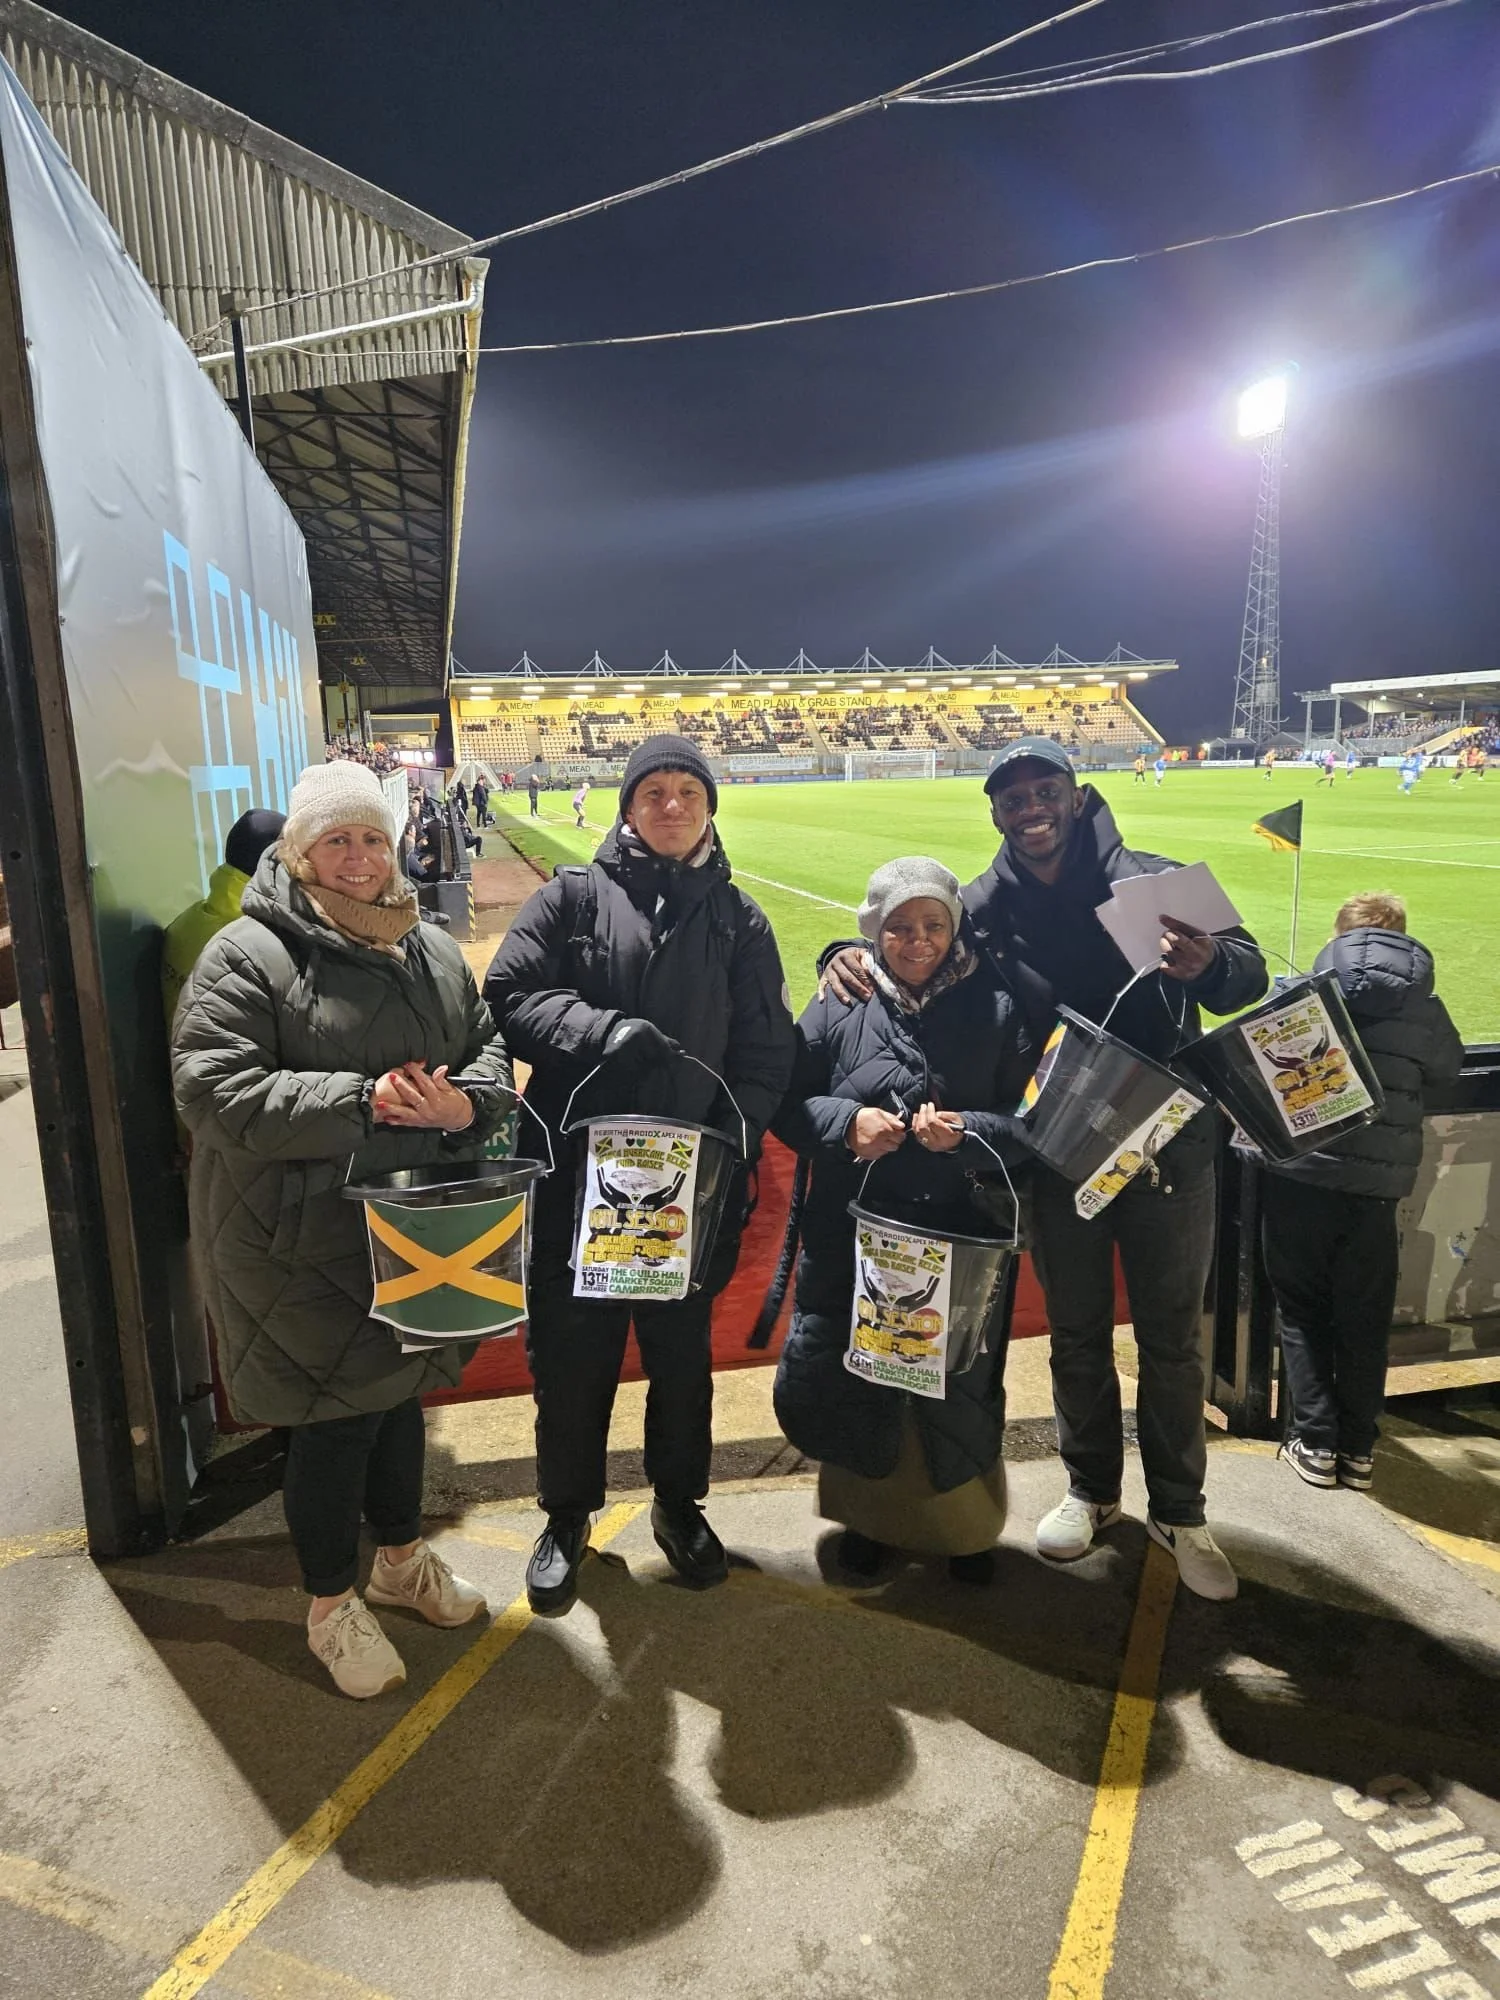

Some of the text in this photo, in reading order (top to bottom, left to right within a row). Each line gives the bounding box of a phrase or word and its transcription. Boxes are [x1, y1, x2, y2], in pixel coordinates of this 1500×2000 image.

[937, 693, 957, 701] MEAD
[1000, 692, 1020, 700] MEAD
[1063, 689, 1083, 697] MEAD
[510, 702, 533, 710] MEAD
[582, 701, 605, 709] MEAD
[653, 700, 674, 708] MEAD
[731, 696, 872, 709] MEAD PLANT & GRAB STAND
[569, 765, 591, 773] MEAD
[610, 764, 627, 772] MEA
[1290, 1111, 1318, 1129] 13TH
[615, 1158, 664, 1171] FUND RAISER
[623, 1147, 665, 1161] HURRICANE
[665, 1153, 692, 1171] RELIEF
[622, 1209, 688, 1233] SESSION
[582, 1271, 608, 1286] 13TH
[610, 1267, 685, 1281] THE GUILD HALL
[610, 1276, 685, 1287] MARKET SQUARE
[609, 1284, 670, 1294] CAMBRIDGE
[881, 1309, 944, 1333] SESSION
[889, 1361, 916, 1375] GUILD
[917, 1366, 942, 1378] HALL
[874, 1371, 929, 1392] CAMBRIDGE
